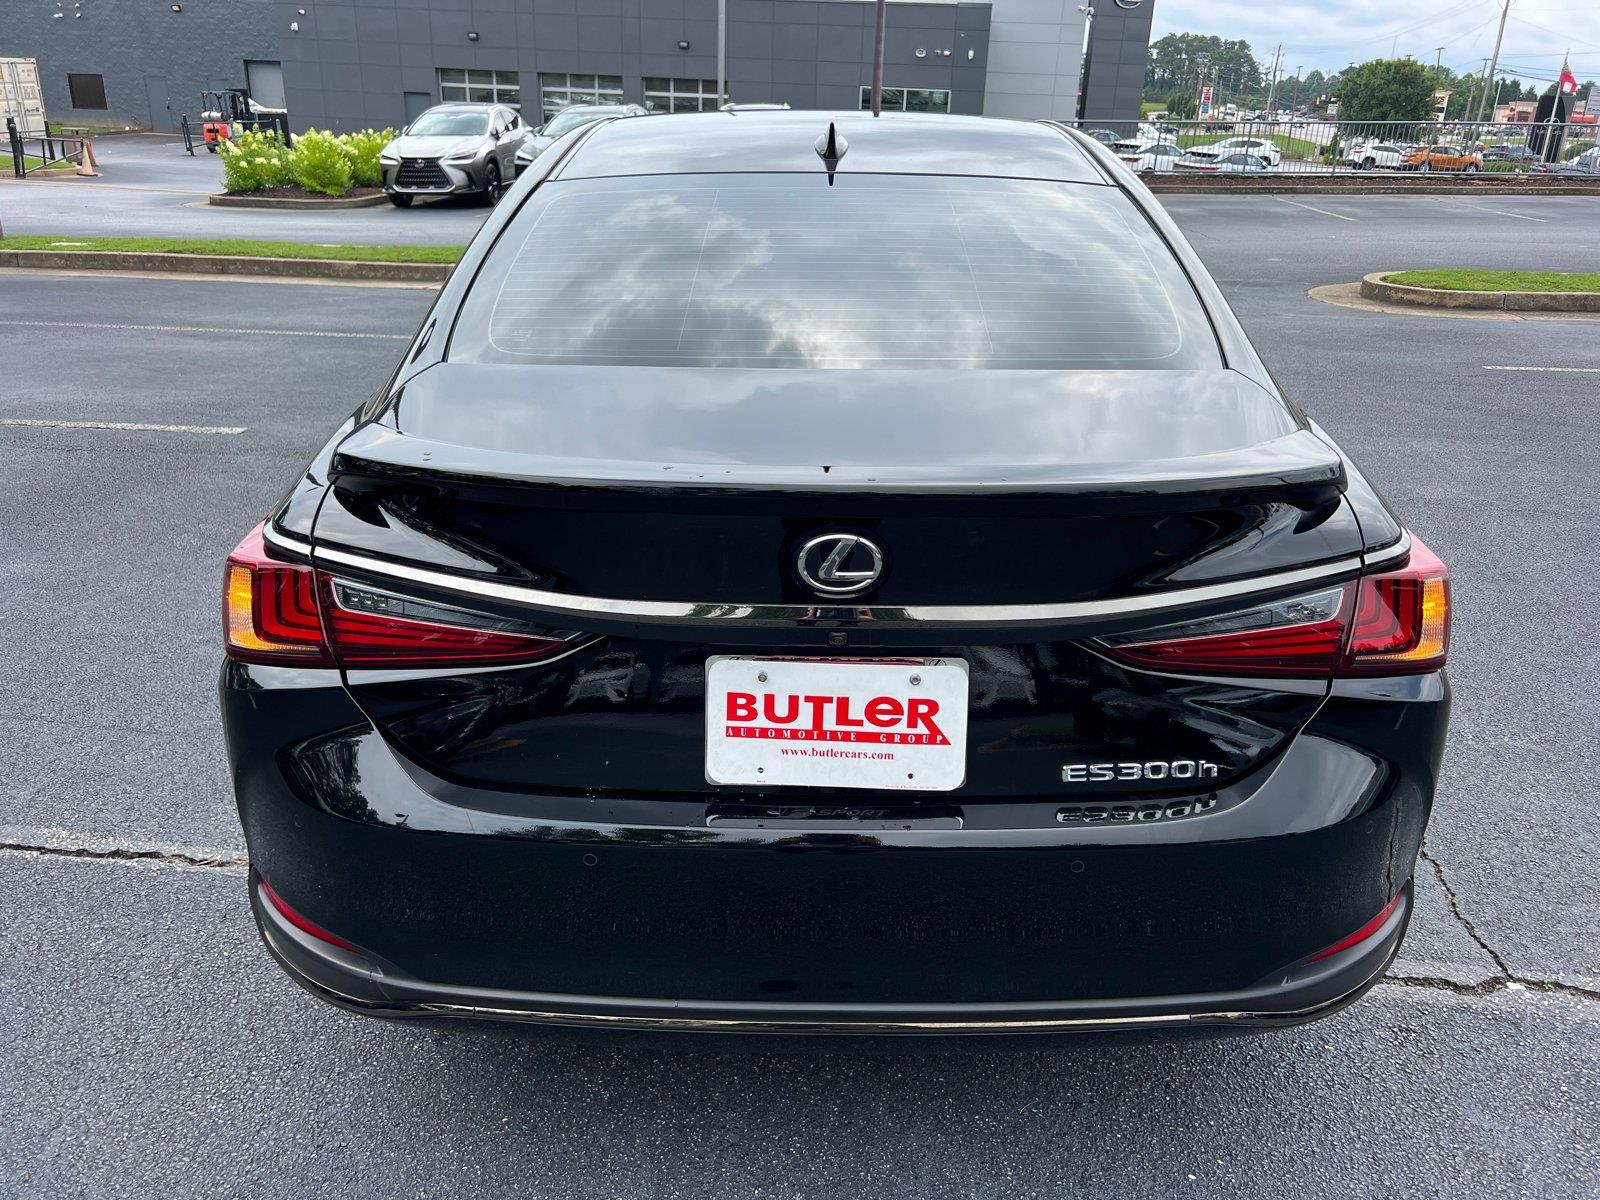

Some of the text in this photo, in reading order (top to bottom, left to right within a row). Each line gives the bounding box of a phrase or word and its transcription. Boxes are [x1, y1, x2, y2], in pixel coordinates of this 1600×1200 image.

[727, 726, 944, 744] AUTOMOTIVE GROUP
[780, 746, 895, 760] www.butlercars.com
